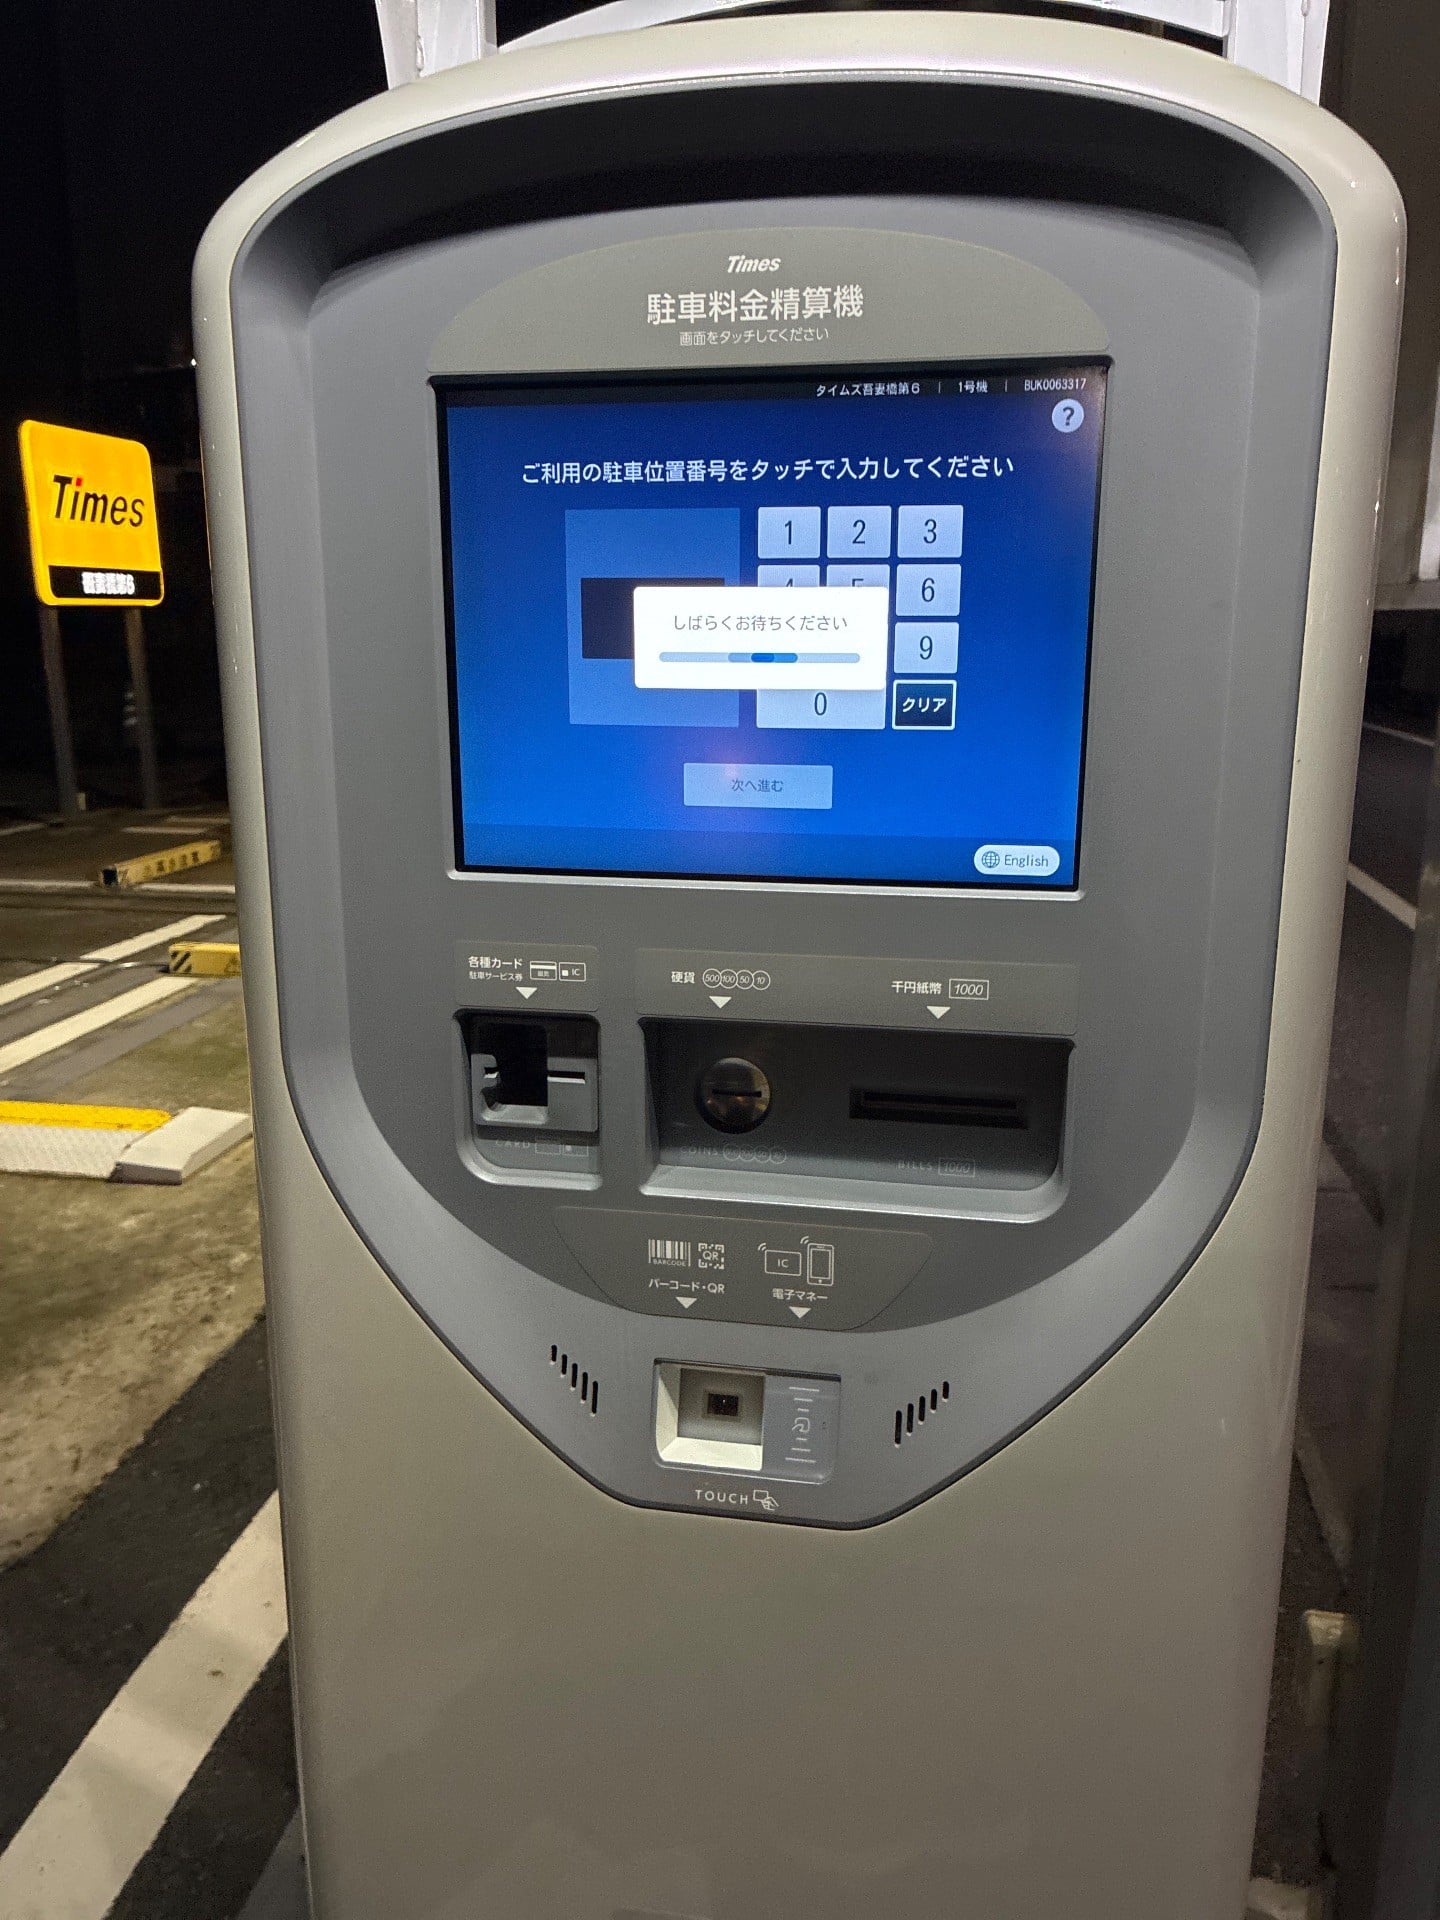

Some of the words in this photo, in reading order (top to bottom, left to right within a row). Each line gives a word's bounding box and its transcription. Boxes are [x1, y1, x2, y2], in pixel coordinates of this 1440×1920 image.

[727, 255, 781, 273] Times
[646, 284, 864, 325] 駐車料金精算機
[679, 327, 829, 346] 画面をタッチしてください
[958, 380, 988, 393] 1号機
[1024, 378, 1087, 391] BUK0063317
[521, 455, 1014, 484] ご利用の駐車位置番号をタッチで入力してください
[53, 474, 145, 527] Times
[784, 520, 793, 545] 1
[852, 519, 866, 544] 2
[923, 519, 937, 544] 3
[921, 577, 935, 602] 6
[673, 615, 848, 631] しばらくお待ちください
[919, 635, 933, 660] 9
[814, 692, 827, 716] 0
[902, 697, 947, 713] クリア
[731, 778, 784, 792] 次へ進む
[1004, 854, 1049, 868] English
[468, 956, 523, 969] 各種カード
[571, 968, 581, 976] IC
[671, 971, 695, 984] 硬貨
[705, 974, 721, 983] 500
[722, 975, 736, 984] 100
[740, 976, 750, 984] 50
[757, 977, 766, 985] 10
[891, 981, 942, 995] 千円紙幣
[954, 984, 984, 996] 1000
[653, 1259, 687, 1267] BARCODE
[703, 1251, 719, 1260] QR
[777, 1259, 789, 1268] IC
[648, 1278, 725, 1294] バーコード・QR
[772, 1288, 828, 1301] 電子マネー
[695, 1489, 749, 1504] TOUCH
